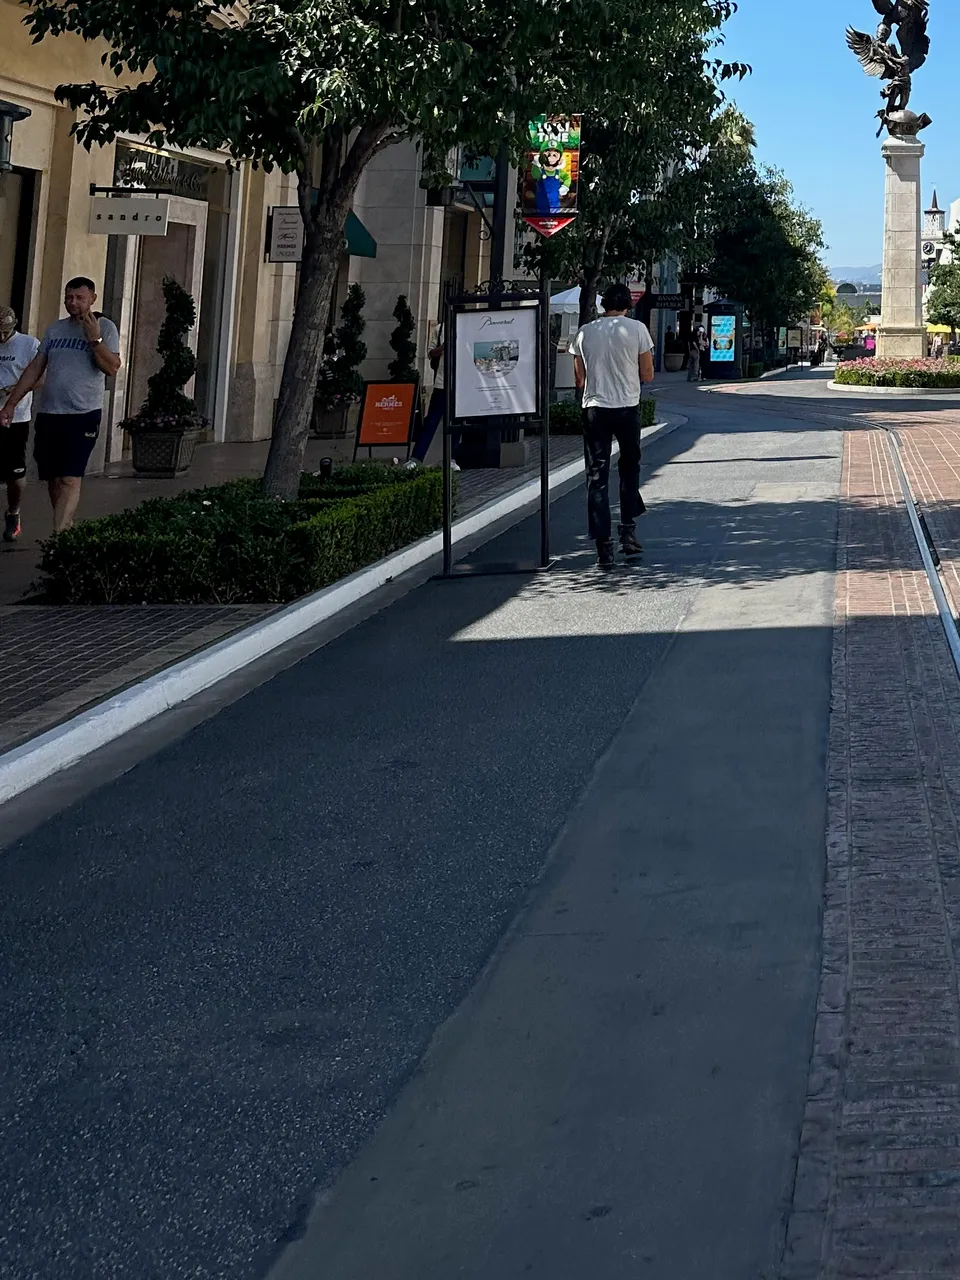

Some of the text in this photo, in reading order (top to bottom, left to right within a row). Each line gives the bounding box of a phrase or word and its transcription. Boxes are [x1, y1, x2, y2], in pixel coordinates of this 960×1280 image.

[536, 121, 570, 132] LUGI
[537, 132, 569, 142] TIME
[96, 212, 162, 222] sandro
[478, 316, 515, 330] Baccarat
